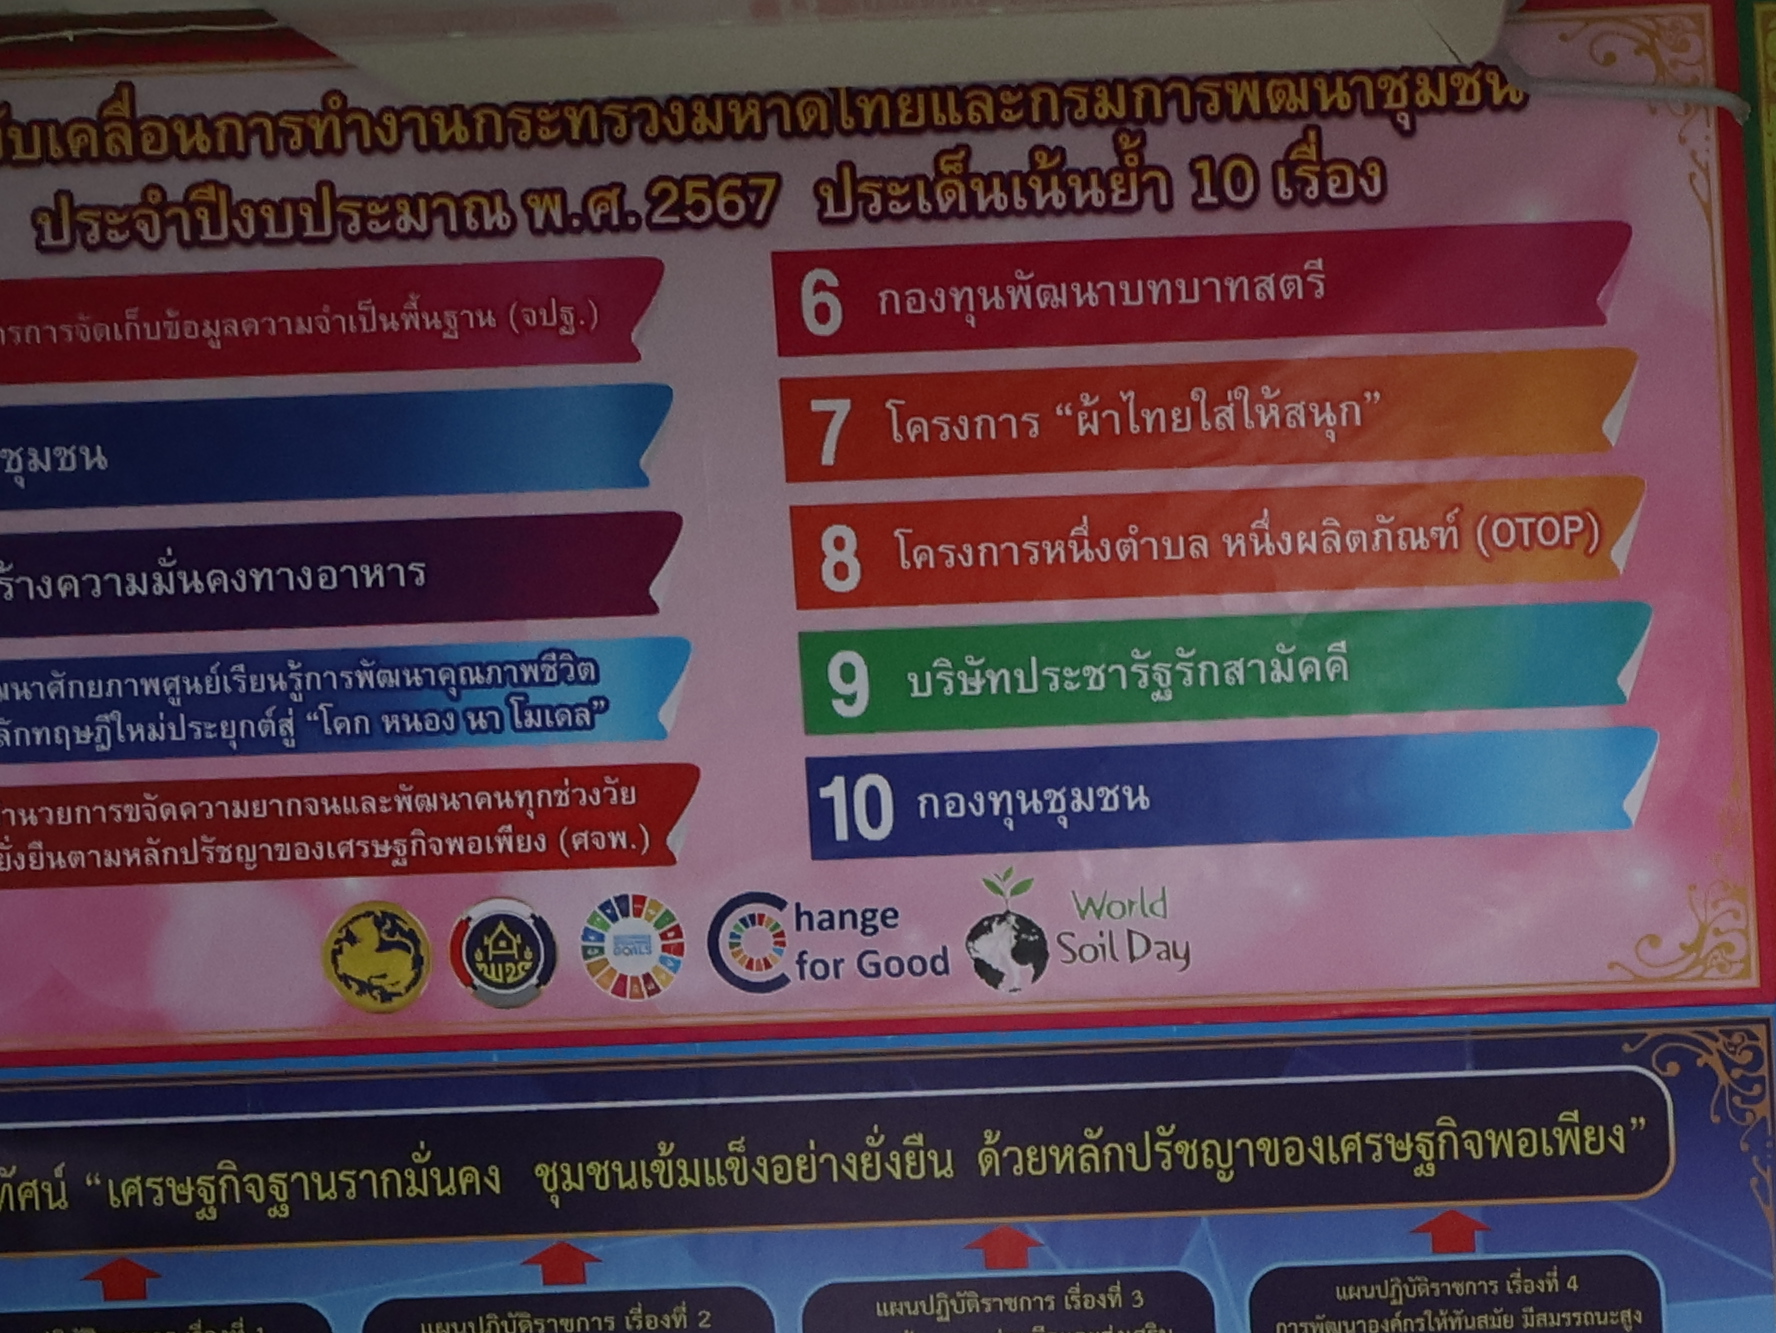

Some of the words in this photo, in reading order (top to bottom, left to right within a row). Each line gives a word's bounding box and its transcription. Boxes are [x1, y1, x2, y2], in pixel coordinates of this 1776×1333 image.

[1190, 155, 1256, 207] 10
[1275, 125, 1388, 202] เรื่อง
[800, 267, 842, 336] 6
[877, 258, 1328, 327] กองทุนพัฒนาบทบาทสตรี
[809, 399, 852, 467] 7
[885, 399, 1041, 445] โครงการ
[818, 525, 861, 593] 8
[893, 514, 1211, 572] โครงการหนึ่งตำบล
[1222, 498, 1459, 556] หนึ่งผลิตภัณฑ์
[1475, 511, 1602, 558] (OTOP)
[827, 650, 871, 718] 9
[907, 640, 1350, 702] บริษัทประชารัฐรักสามัคคี
[383, 704, 456, 736] หนอง
[466, 708, 502, 734] นา
[818, 772, 896, 843] 10
[918, 778, 1151, 830] กองทุนชุมชน
[1071, 886, 1169, 922] World
[794, 948, 847, 983] for
[857, 944, 952, 980] Good
[1056, 927, 1119, 966] Soil
[1129, 929, 1193, 972] Day
[535, 1122, 954, 1210] ชุมชนเข้มแข็งอย่างยั่งยืน
[698, 1309, 713, 1330] 2
[1131, 1289, 1145, 1310] 3
